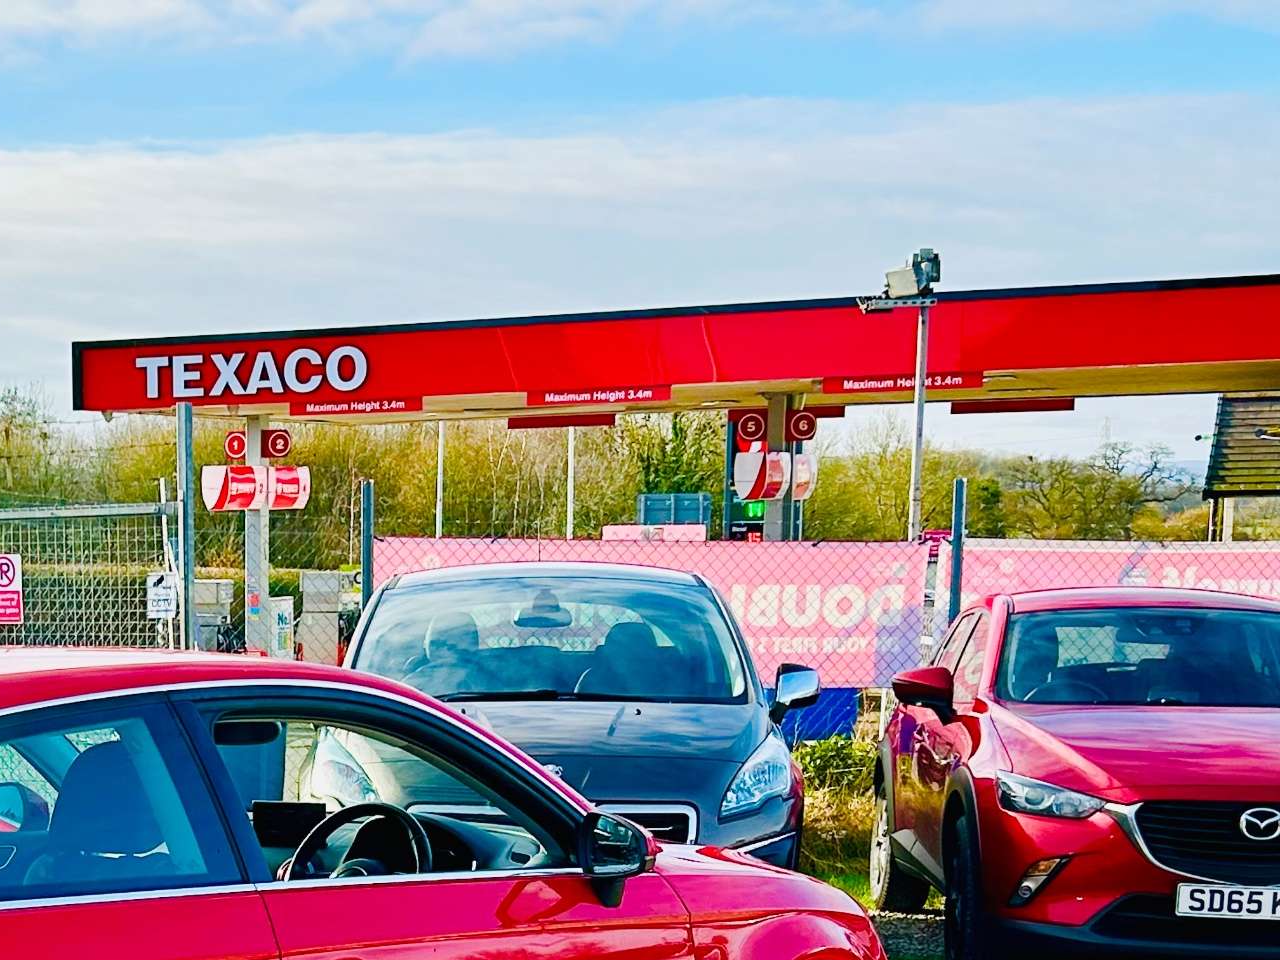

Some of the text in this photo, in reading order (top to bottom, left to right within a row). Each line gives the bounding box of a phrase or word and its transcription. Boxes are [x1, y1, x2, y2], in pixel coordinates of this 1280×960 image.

[136, 346, 368, 399] TEXACO
[842, 375, 962, 390] Maximum Heit 3.4m
[544, 389, 653, 402] Maximum Height 3.4m
[306, 400, 406, 413] Maximum Height 3.4m
[746, 421, 756, 432] 5
[798, 420, 809, 431] 6
[275, 438, 285, 450] 2
[1188, 888, 1263, 914] SD65
